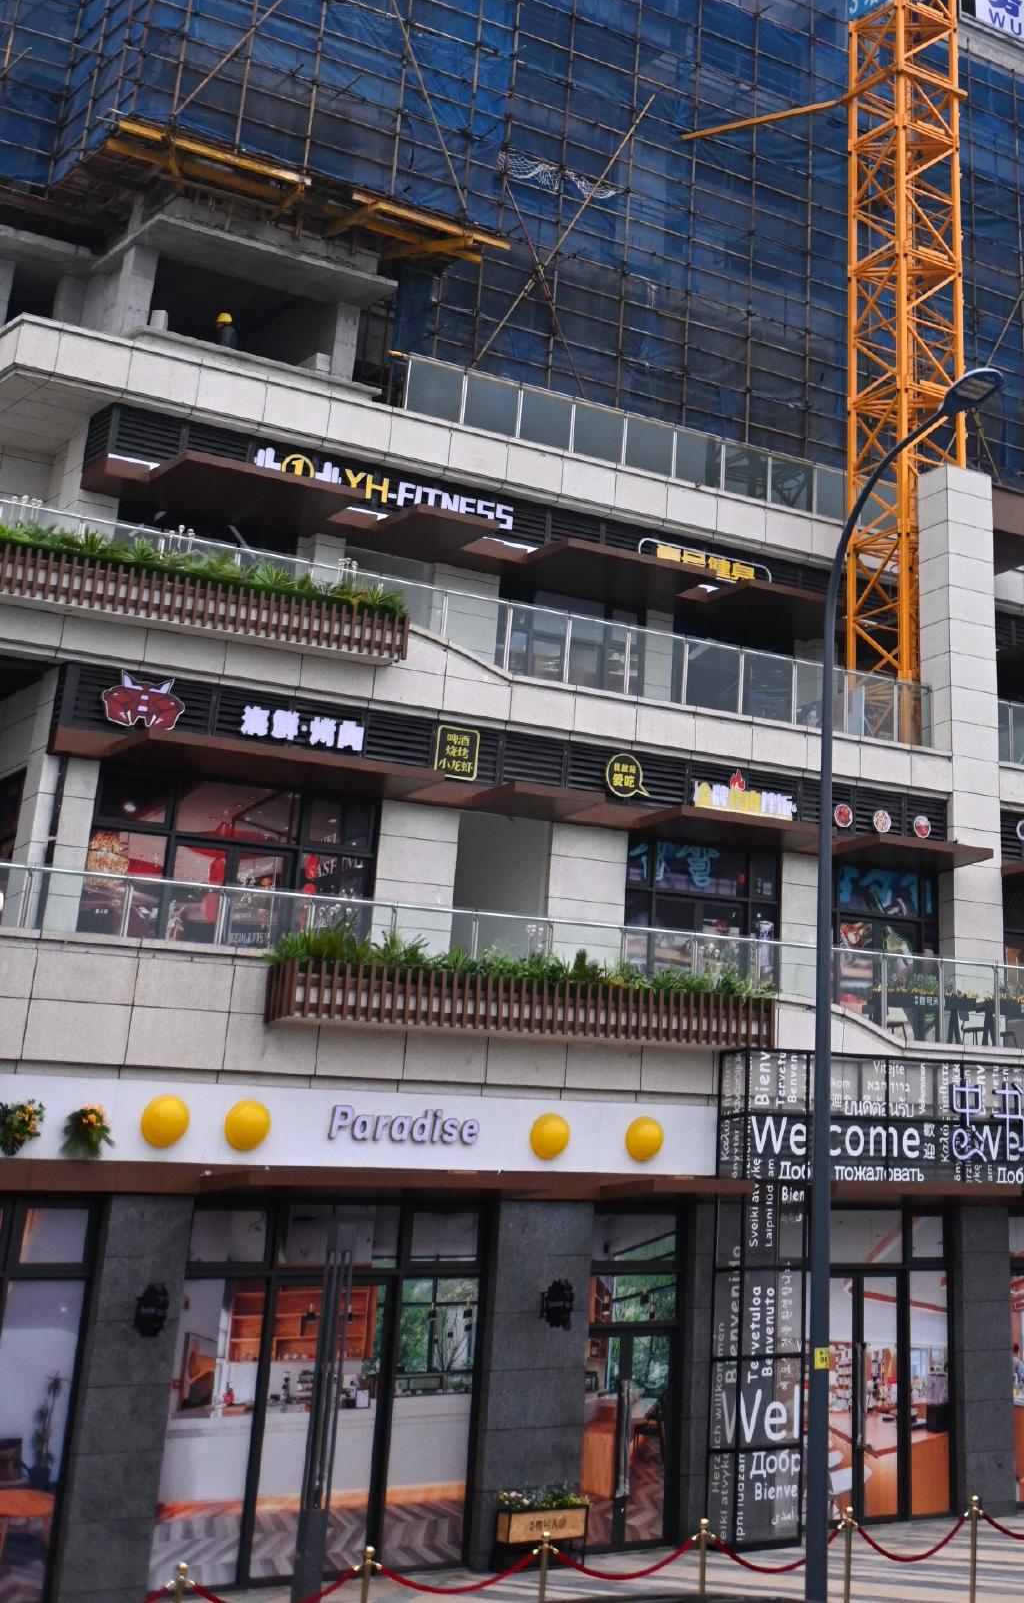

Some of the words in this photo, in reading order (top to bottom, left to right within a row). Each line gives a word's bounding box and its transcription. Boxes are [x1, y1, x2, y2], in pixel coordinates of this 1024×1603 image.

[988, 8, 1023, 37] WU
[447, 733, 471, 747] 啤酒
[445, 745, 470, 759] 烧烤
[438, 757, 474, 774] 小龙虾
[328, 1104, 480, 1146] Paradise
[751, 1115, 921, 1158] Wecome
